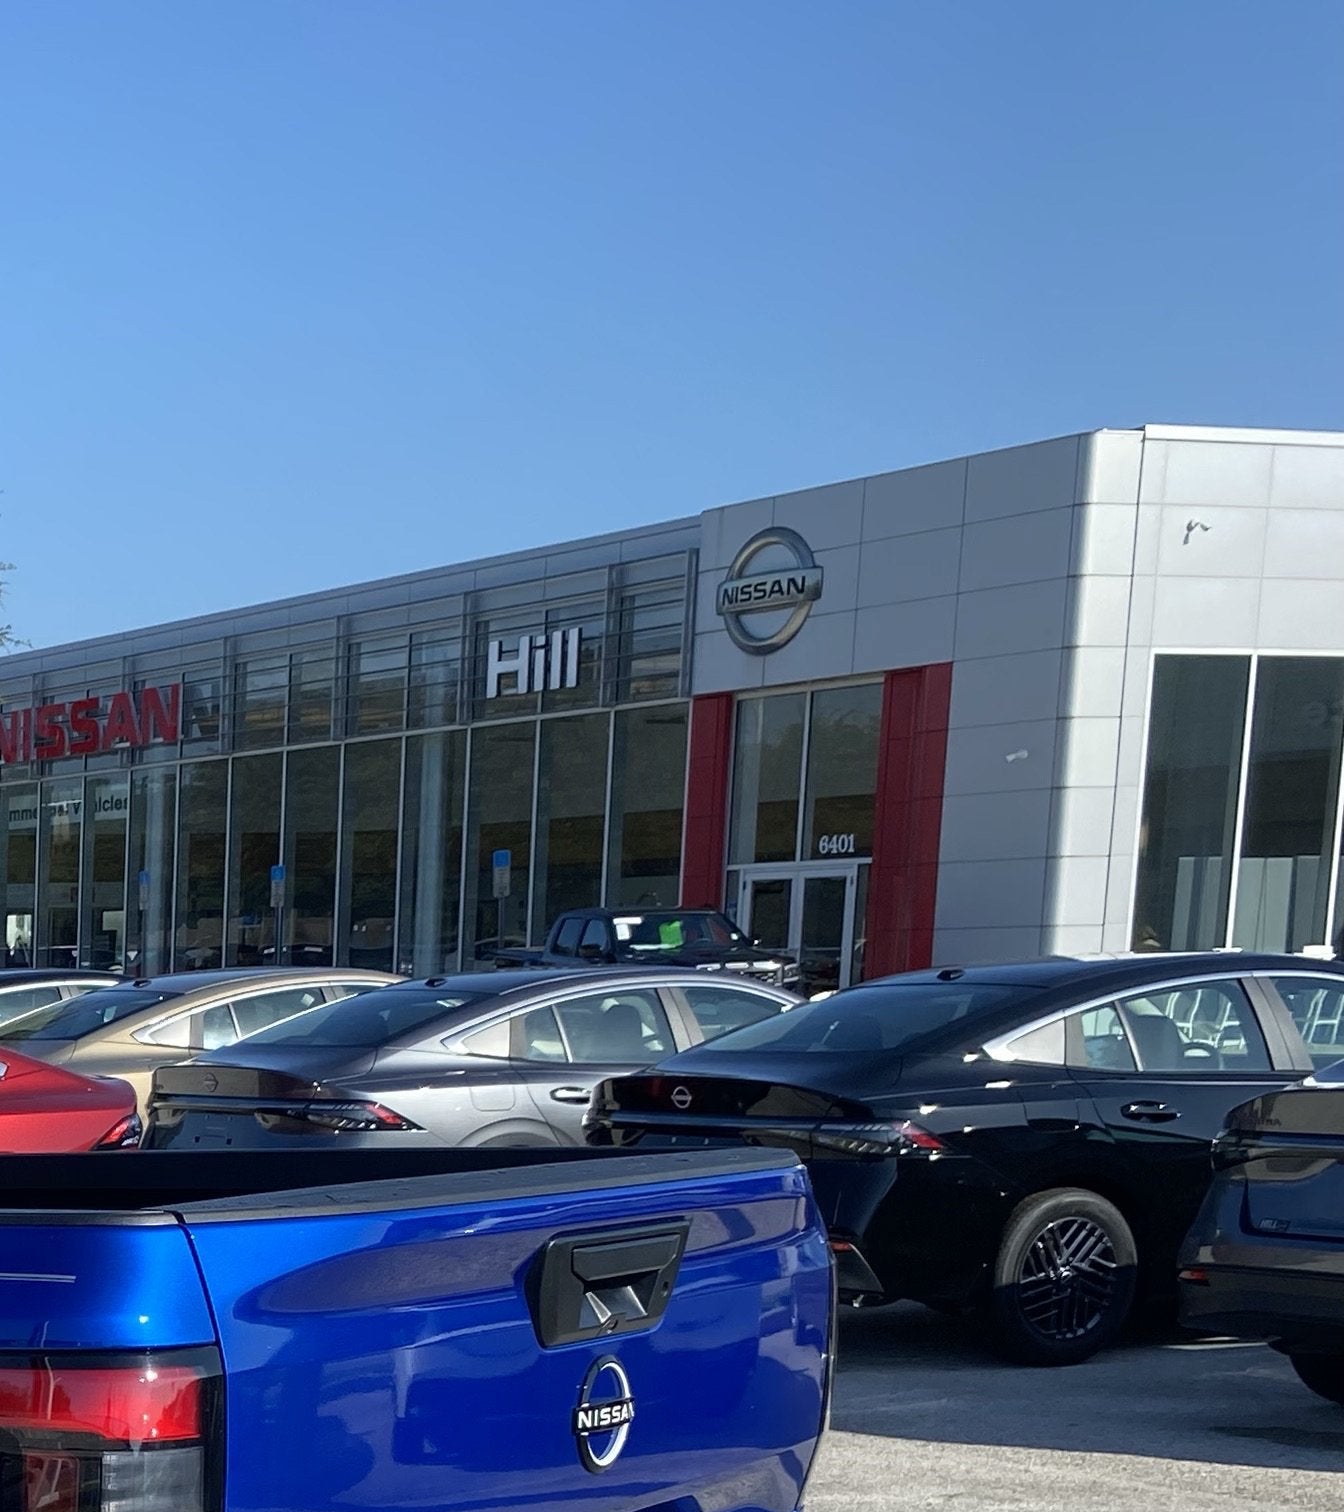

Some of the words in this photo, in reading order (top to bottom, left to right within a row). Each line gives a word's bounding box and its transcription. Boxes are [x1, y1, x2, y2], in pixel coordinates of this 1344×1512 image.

[721, 574, 807, 607] NISSAN
[486, 627, 582, 698] Hill
[819, 834, 856, 854] 6401
